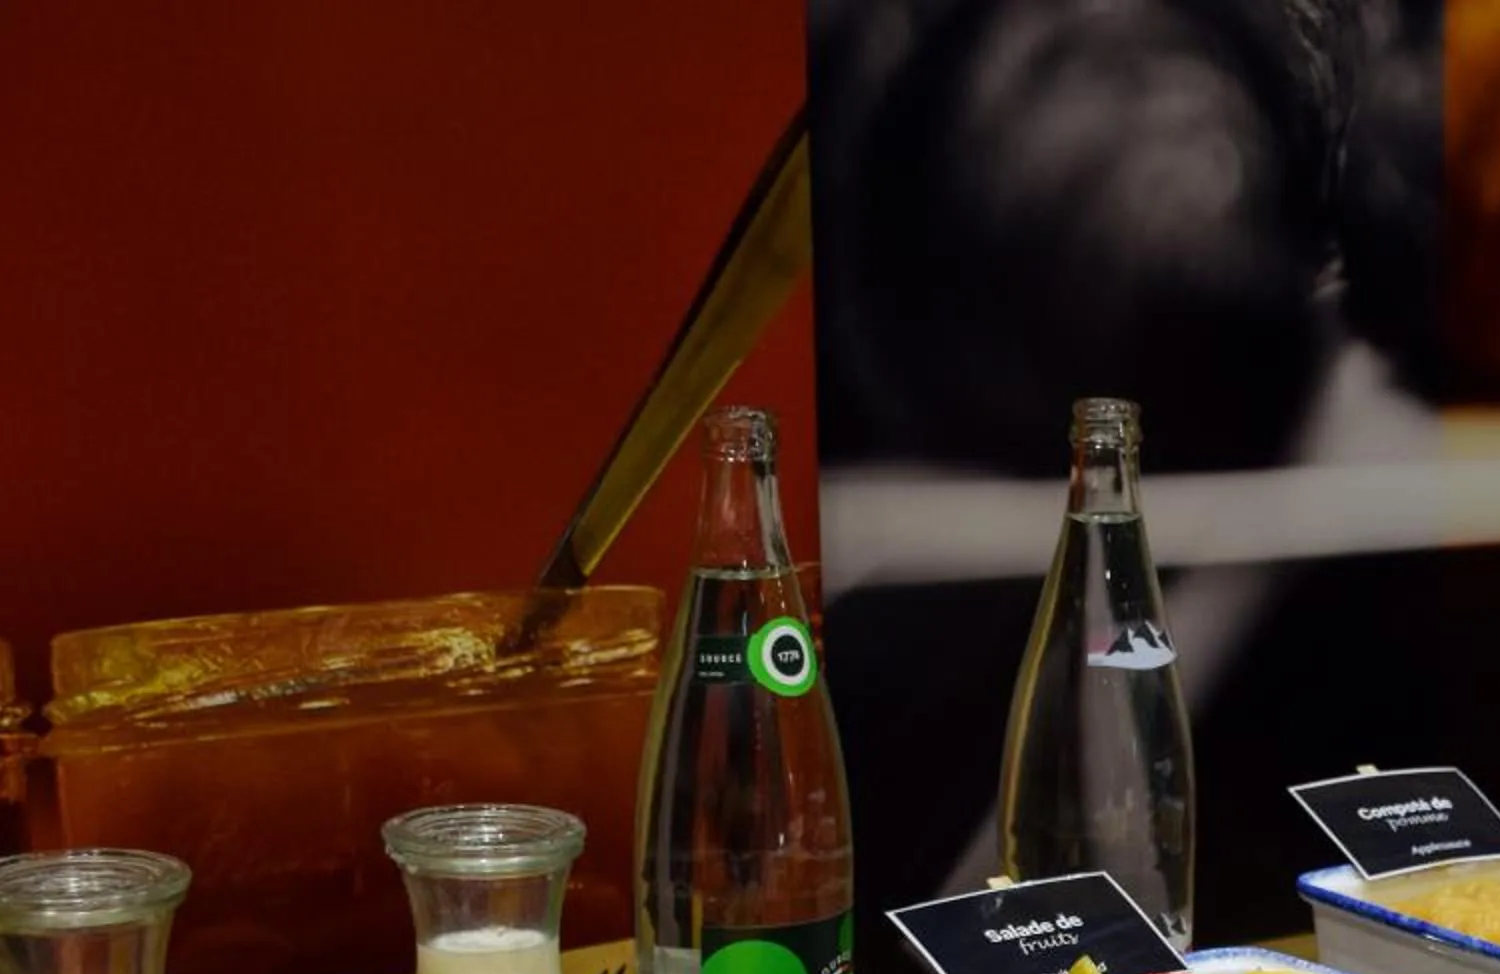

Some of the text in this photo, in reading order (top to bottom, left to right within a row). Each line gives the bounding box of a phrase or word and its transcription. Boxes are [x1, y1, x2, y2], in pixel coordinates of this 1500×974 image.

[984, 913, 1084, 944] Salade de
[1018, 932, 1081, 957] fruits
